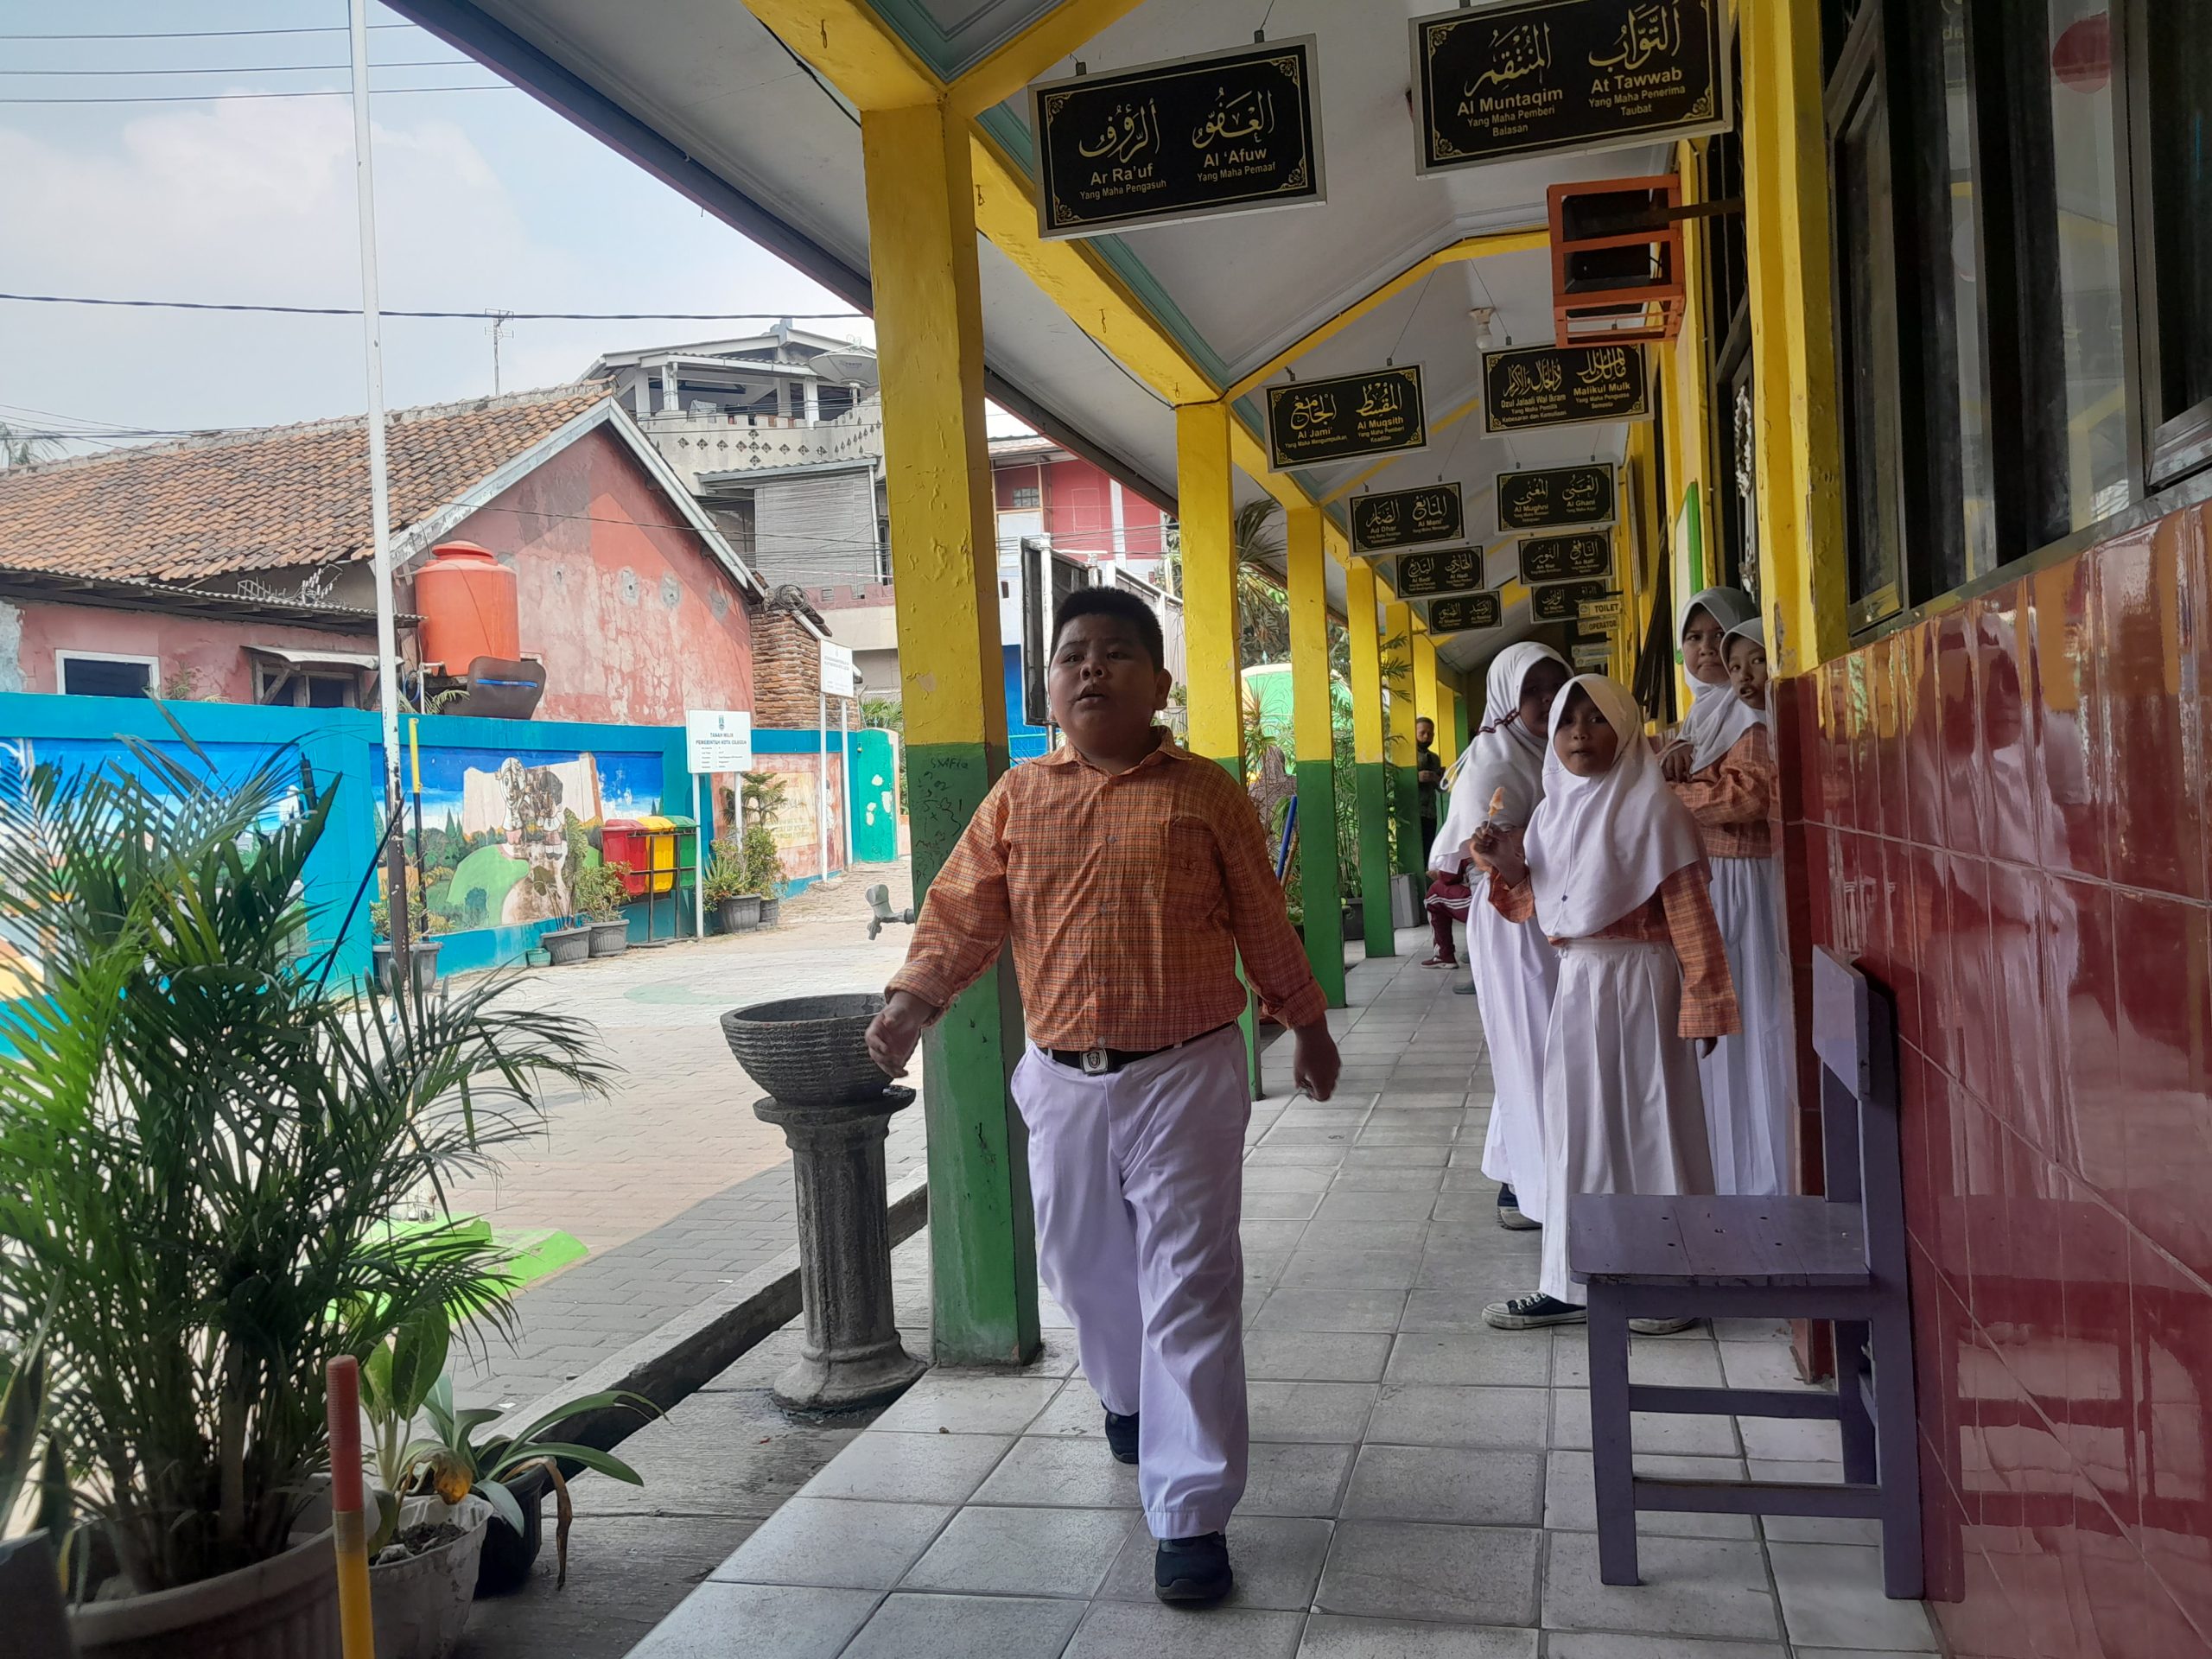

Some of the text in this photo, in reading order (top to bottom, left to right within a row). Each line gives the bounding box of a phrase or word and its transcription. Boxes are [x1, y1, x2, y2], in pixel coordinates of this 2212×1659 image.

[1591, 67, 1682, 94] At Tawwab
[1457, 88, 1563, 117] Al Muntaqim
[1588, 86, 1686, 108] Yang Maha Penerima
[1467, 105, 1555, 128] Yang Maha Pemberi
[1620, 104, 1652, 116] Taubat
[1492, 124, 1529, 137] Balasan
[1204, 153, 1219, 168] Al
[1090, 162, 1154, 186] Ar Ra'uf
[1197, 162, 1275, 182] Yang Maha Pemaaf
[1080, 179, 1166, 200] Yang Maha Pengasuh
[1573, 382, 1630, 396] Malikul Mulk
[1357, 416, 1404, 430] Al Muqsith
[1298, 430, 1307, 439] Al
[1594, 604, 1618, 613] TOILET
